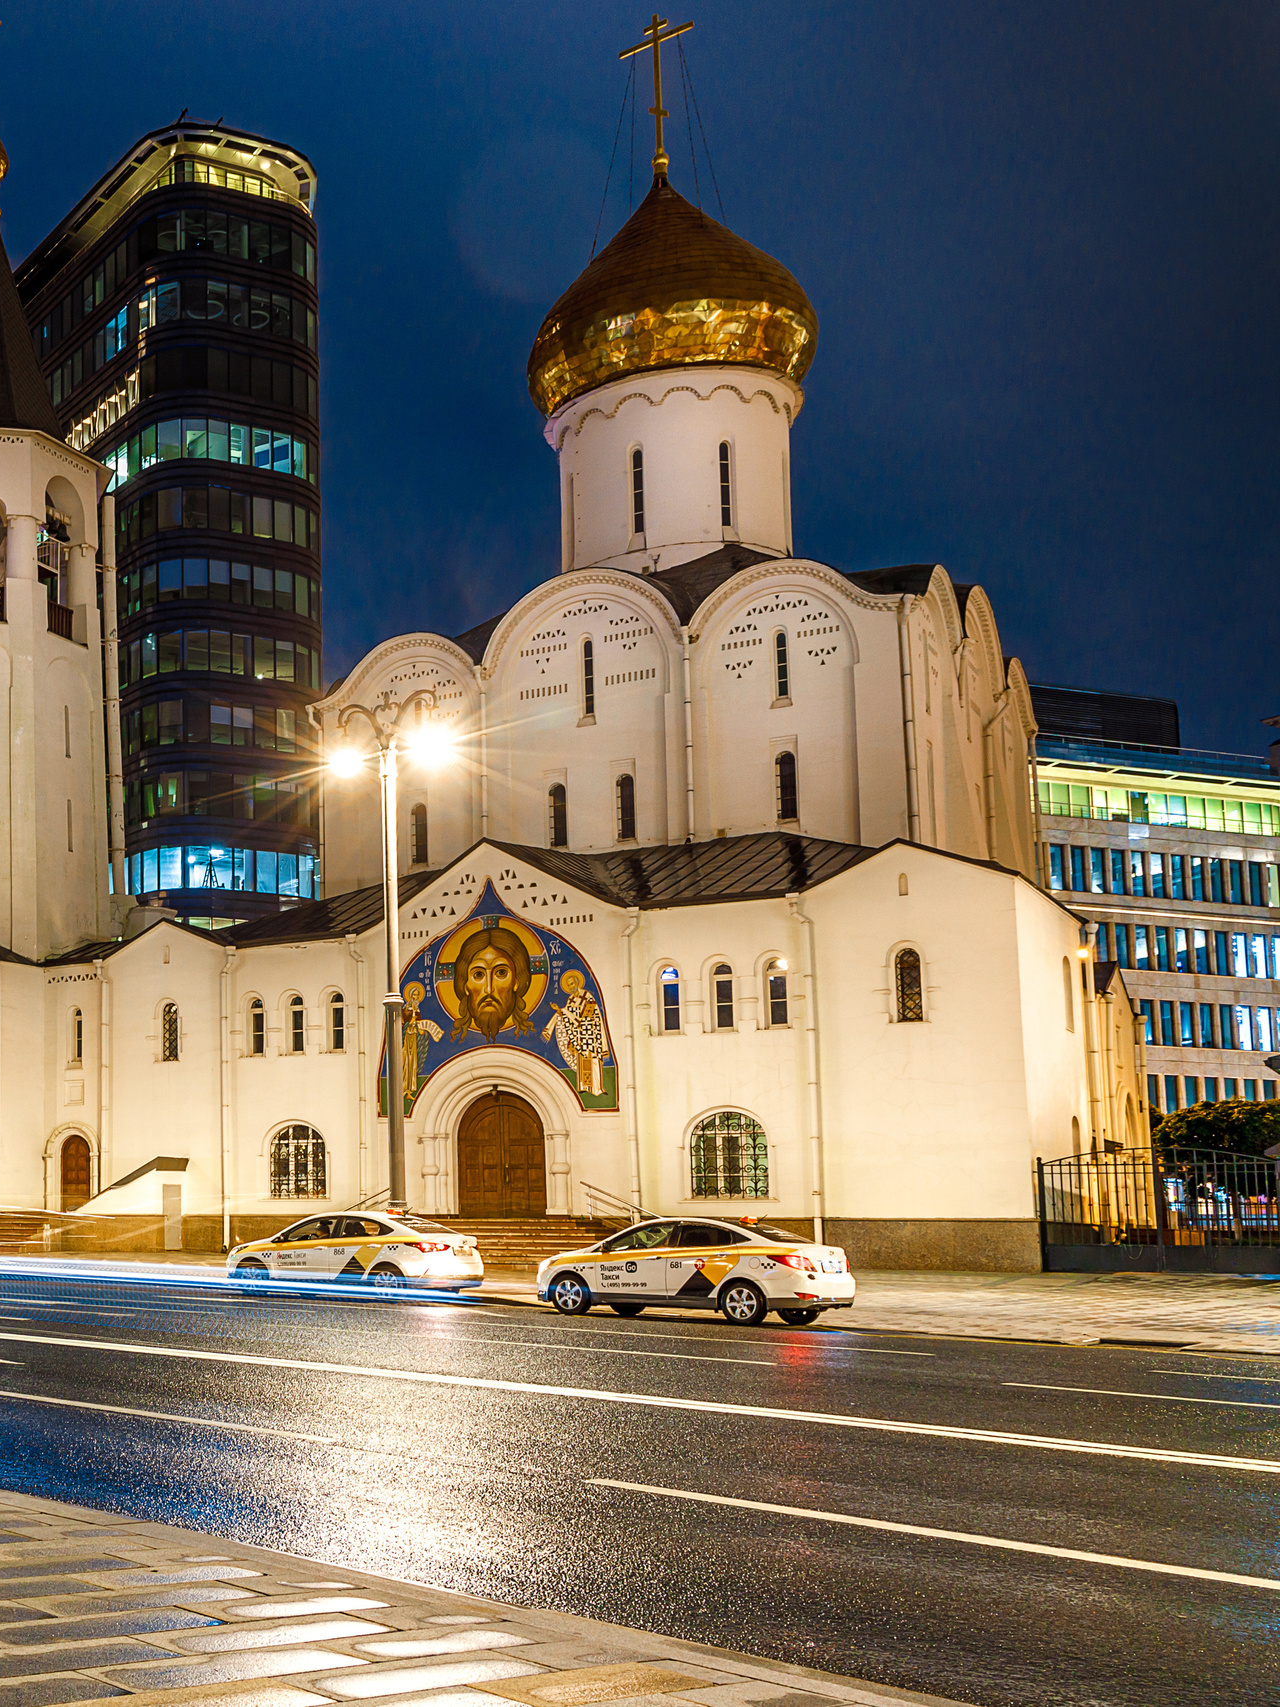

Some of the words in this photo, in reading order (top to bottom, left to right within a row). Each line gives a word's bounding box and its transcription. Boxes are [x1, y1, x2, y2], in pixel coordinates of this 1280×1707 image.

[333, 1248, 345, 1256] 868
[600, 1264, 624, 1272] Яндекс
[627, 1263, 636, 1271] Go
[669, 1261, 682, 1269] 681
[601, 1273, 620, 1281] Такси
